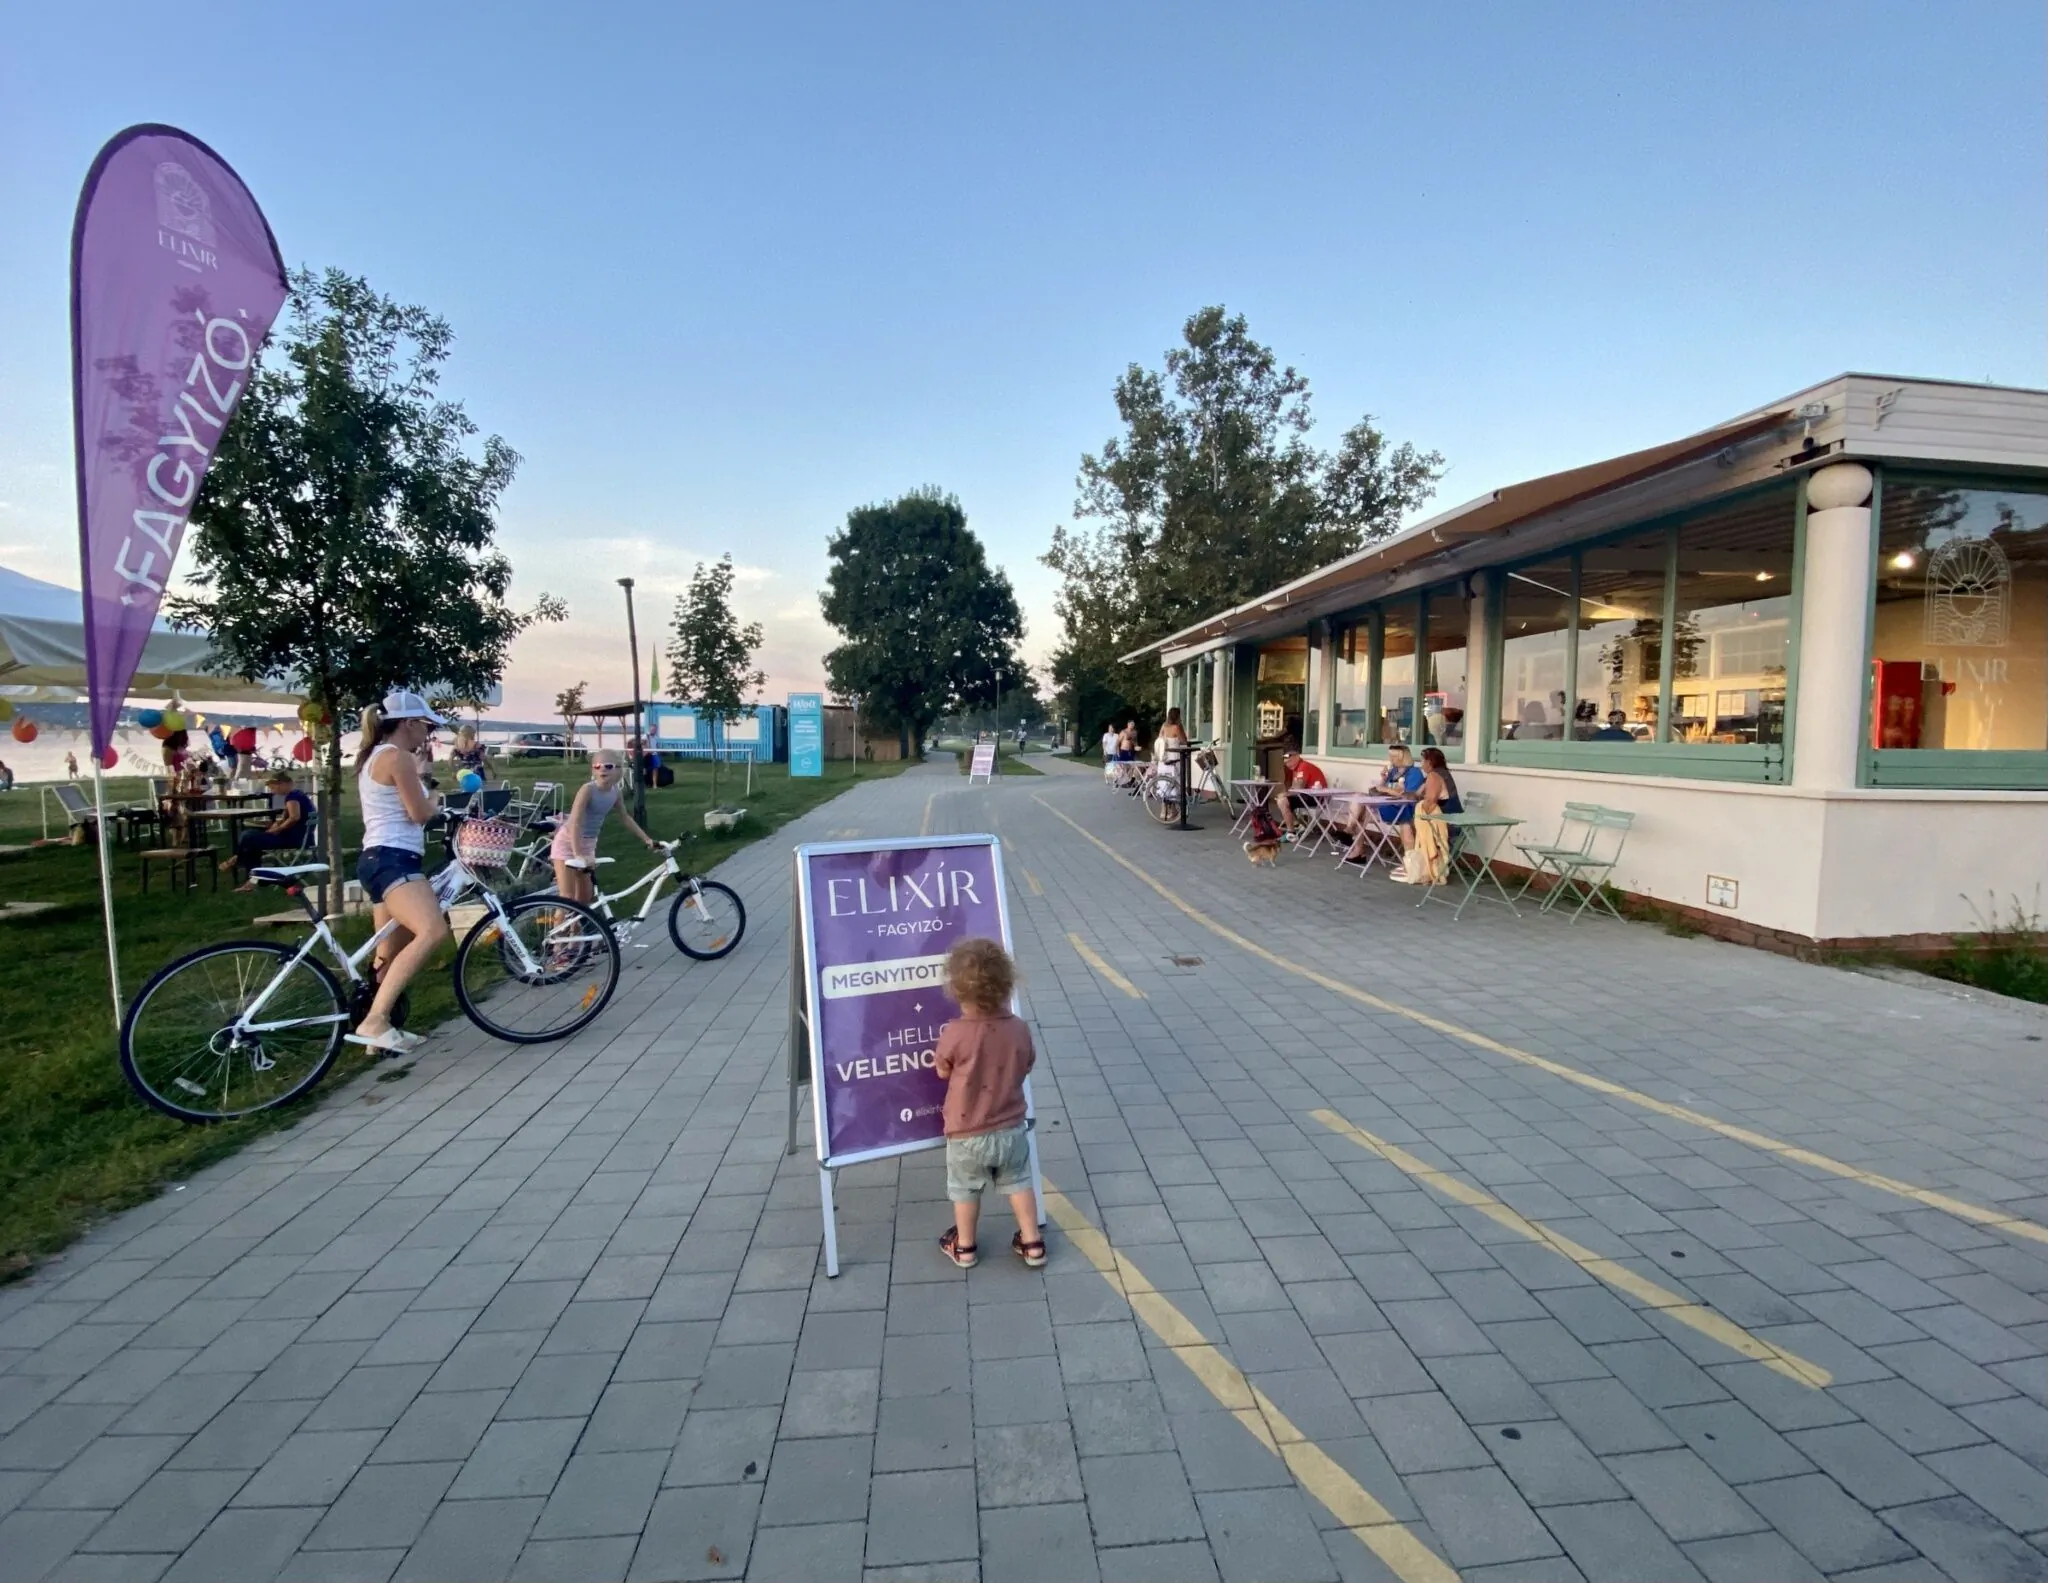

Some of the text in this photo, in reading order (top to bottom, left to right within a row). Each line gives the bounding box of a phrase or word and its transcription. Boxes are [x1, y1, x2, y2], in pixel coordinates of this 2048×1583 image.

[114, 308, 250, 593] FAGYIZÓ
[828, 861, 982, 917] ELIXÍR
[877, 916, 944, 937] FAGYIZÓ
